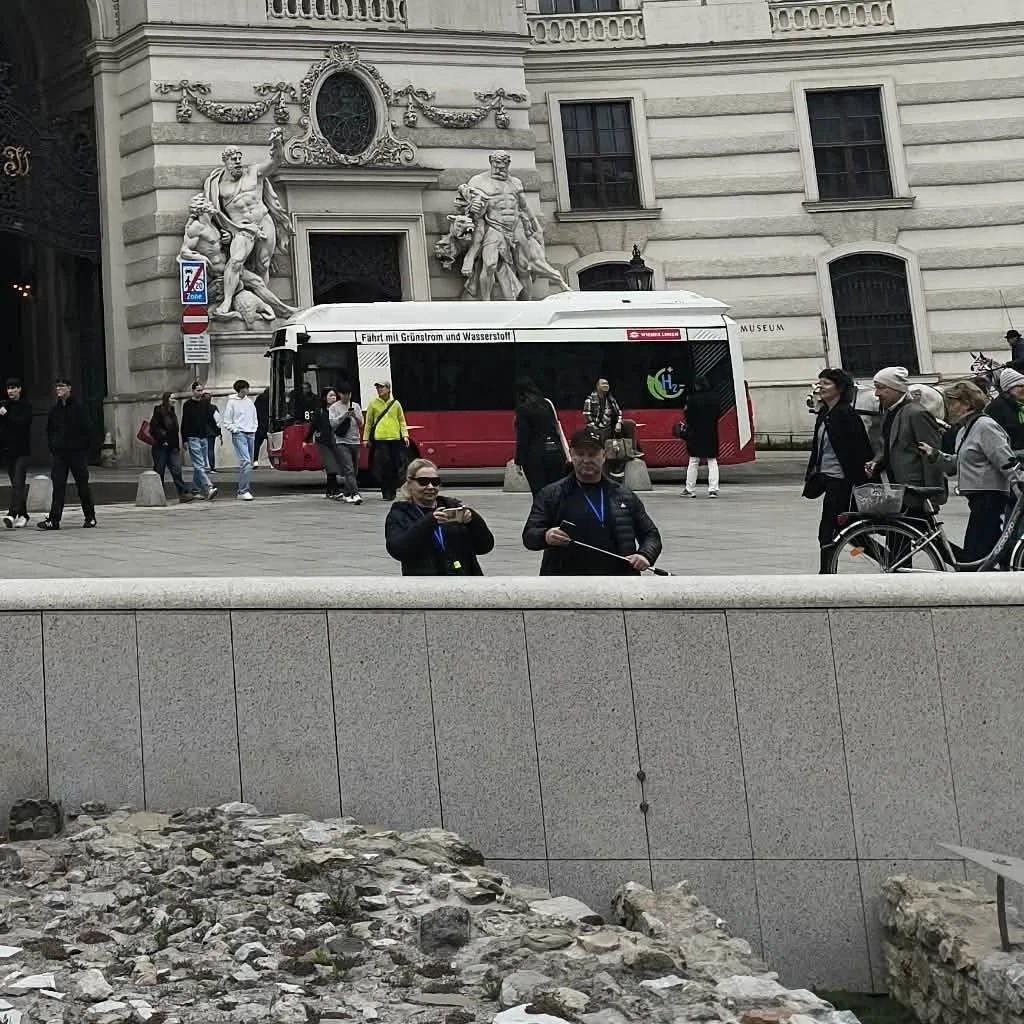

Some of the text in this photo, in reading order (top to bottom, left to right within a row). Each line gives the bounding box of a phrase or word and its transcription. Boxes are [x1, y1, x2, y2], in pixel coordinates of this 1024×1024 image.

[740, 323, 785, 333] MUSEUM
[361, 330, 511, 342] Fahrt mit Grünstrom und Wasserstoff
